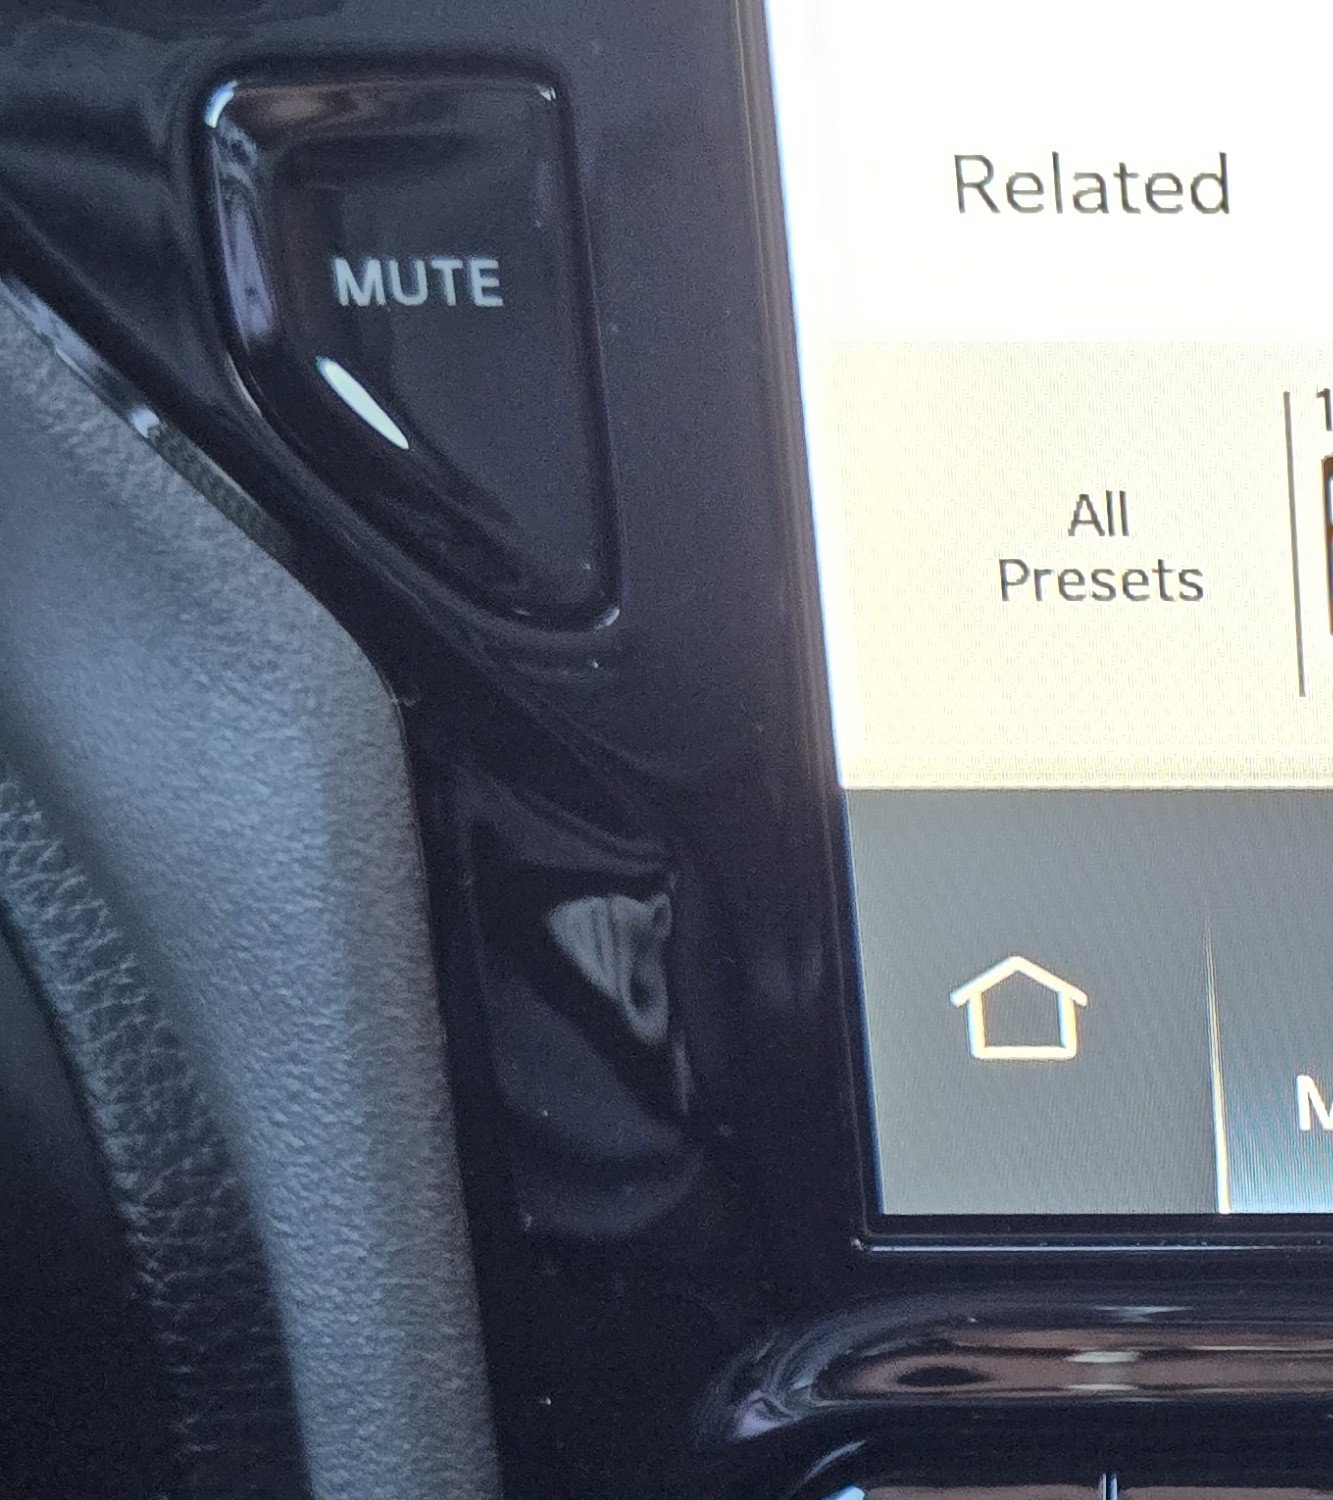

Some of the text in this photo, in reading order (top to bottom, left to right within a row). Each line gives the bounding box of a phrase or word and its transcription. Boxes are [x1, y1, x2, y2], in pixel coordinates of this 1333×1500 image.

[952, 151, 1231, 216] Related
[333, 257, 504, 307] MUTE
[1068, 490, 1130, 538] All
[1000, 558, 1204, 603] Presets
